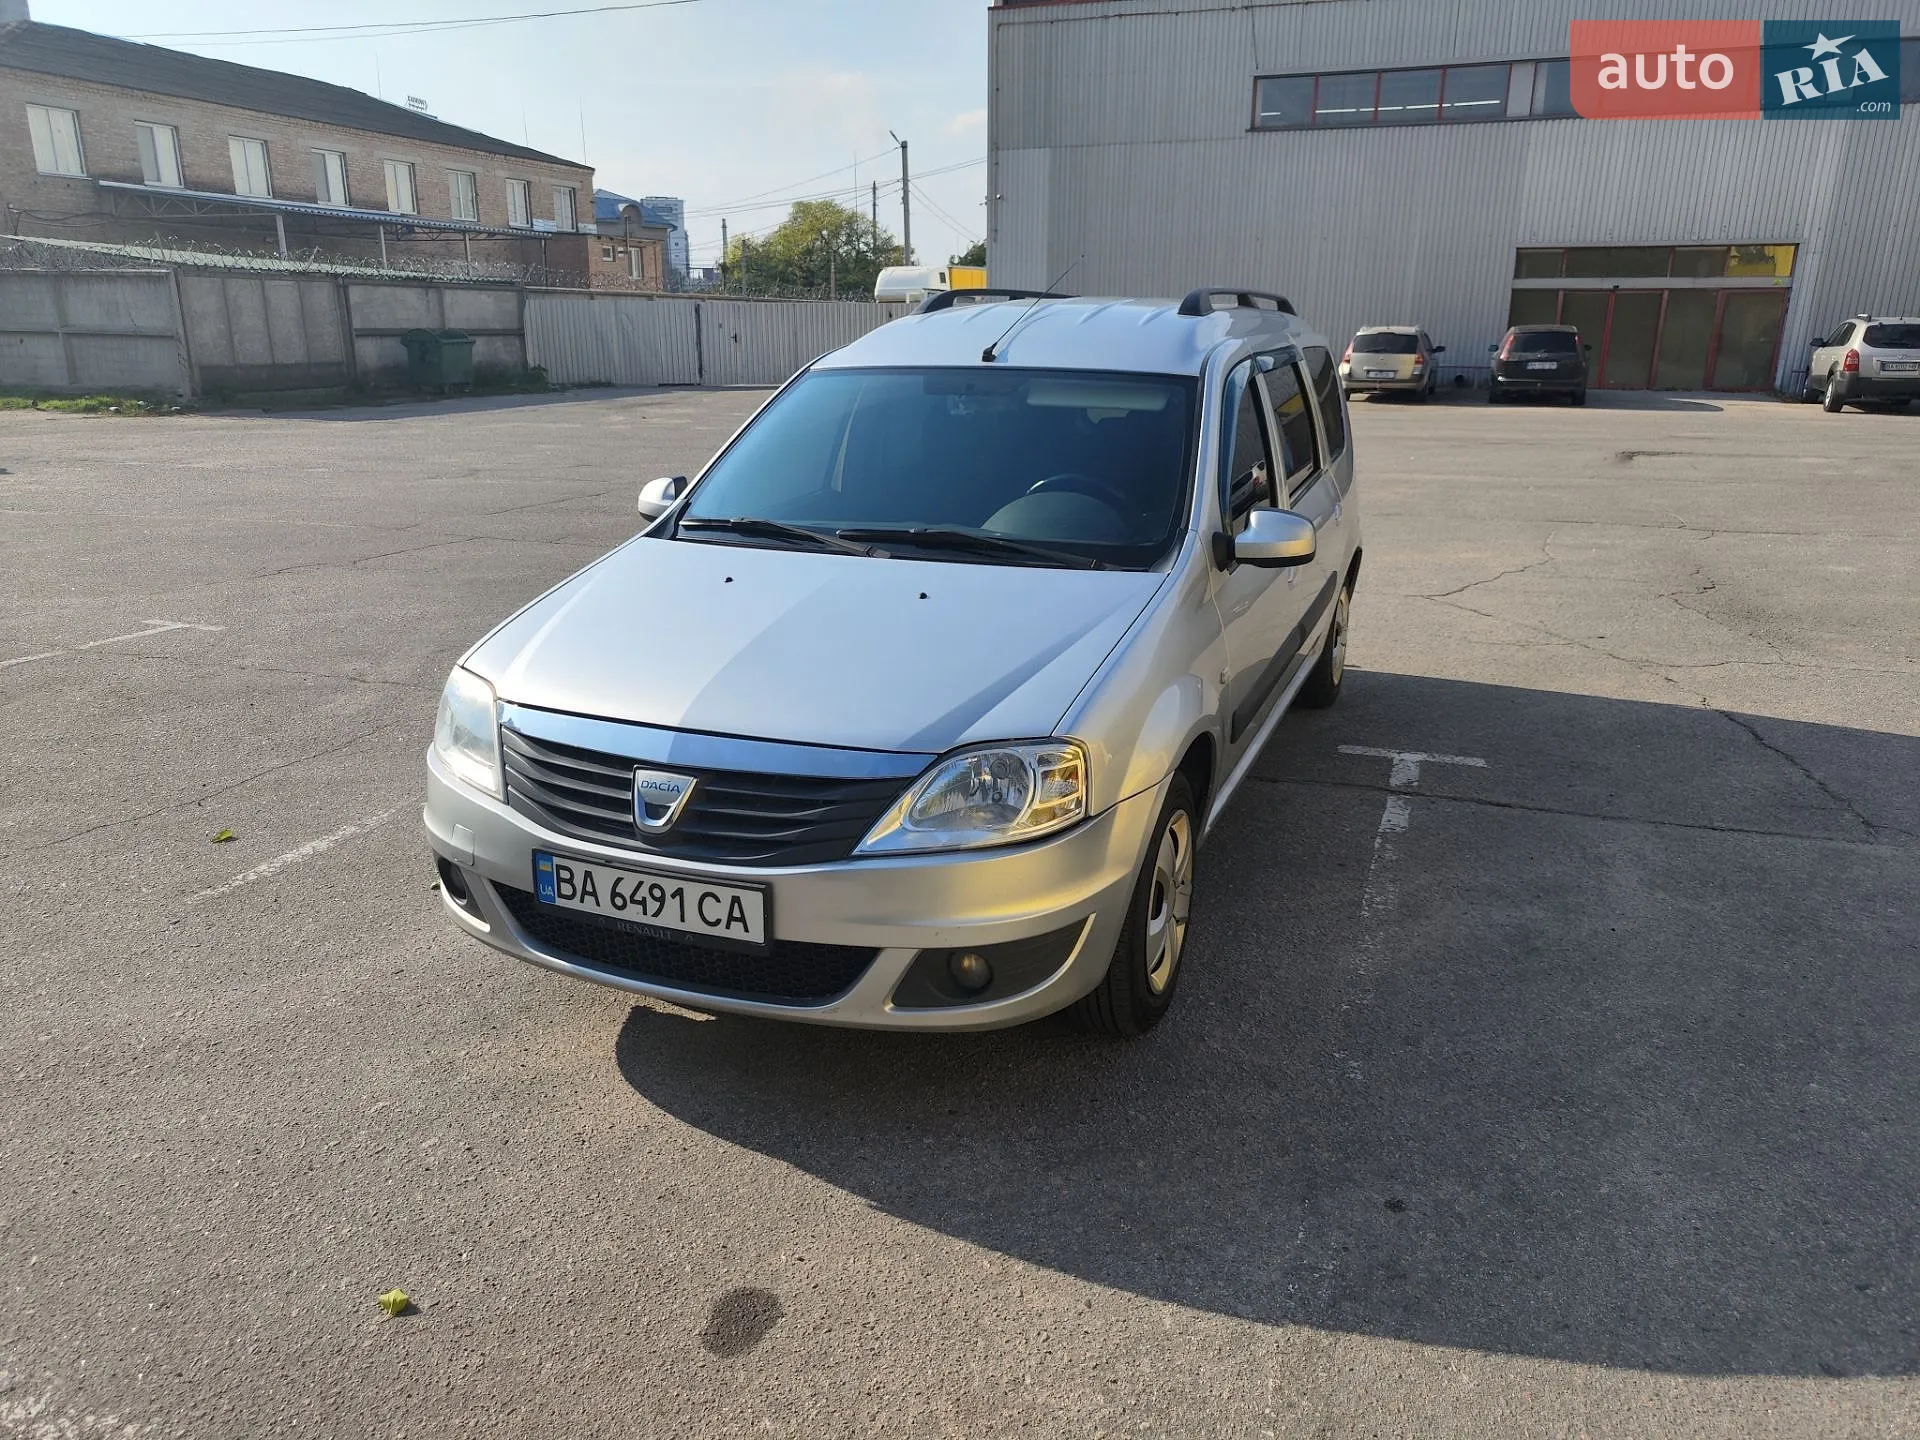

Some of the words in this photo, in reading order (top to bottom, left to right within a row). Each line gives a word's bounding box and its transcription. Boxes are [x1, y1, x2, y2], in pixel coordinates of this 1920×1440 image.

[640, 780, 681, 793] DACIA
[539, 884, 554, 897] UA
[555, 863, 600, 907] BA
[610, 877, 685, 923] 6491
[698, 891, 749, 933] CA
[617, 921, 672, 940] RENAULT
